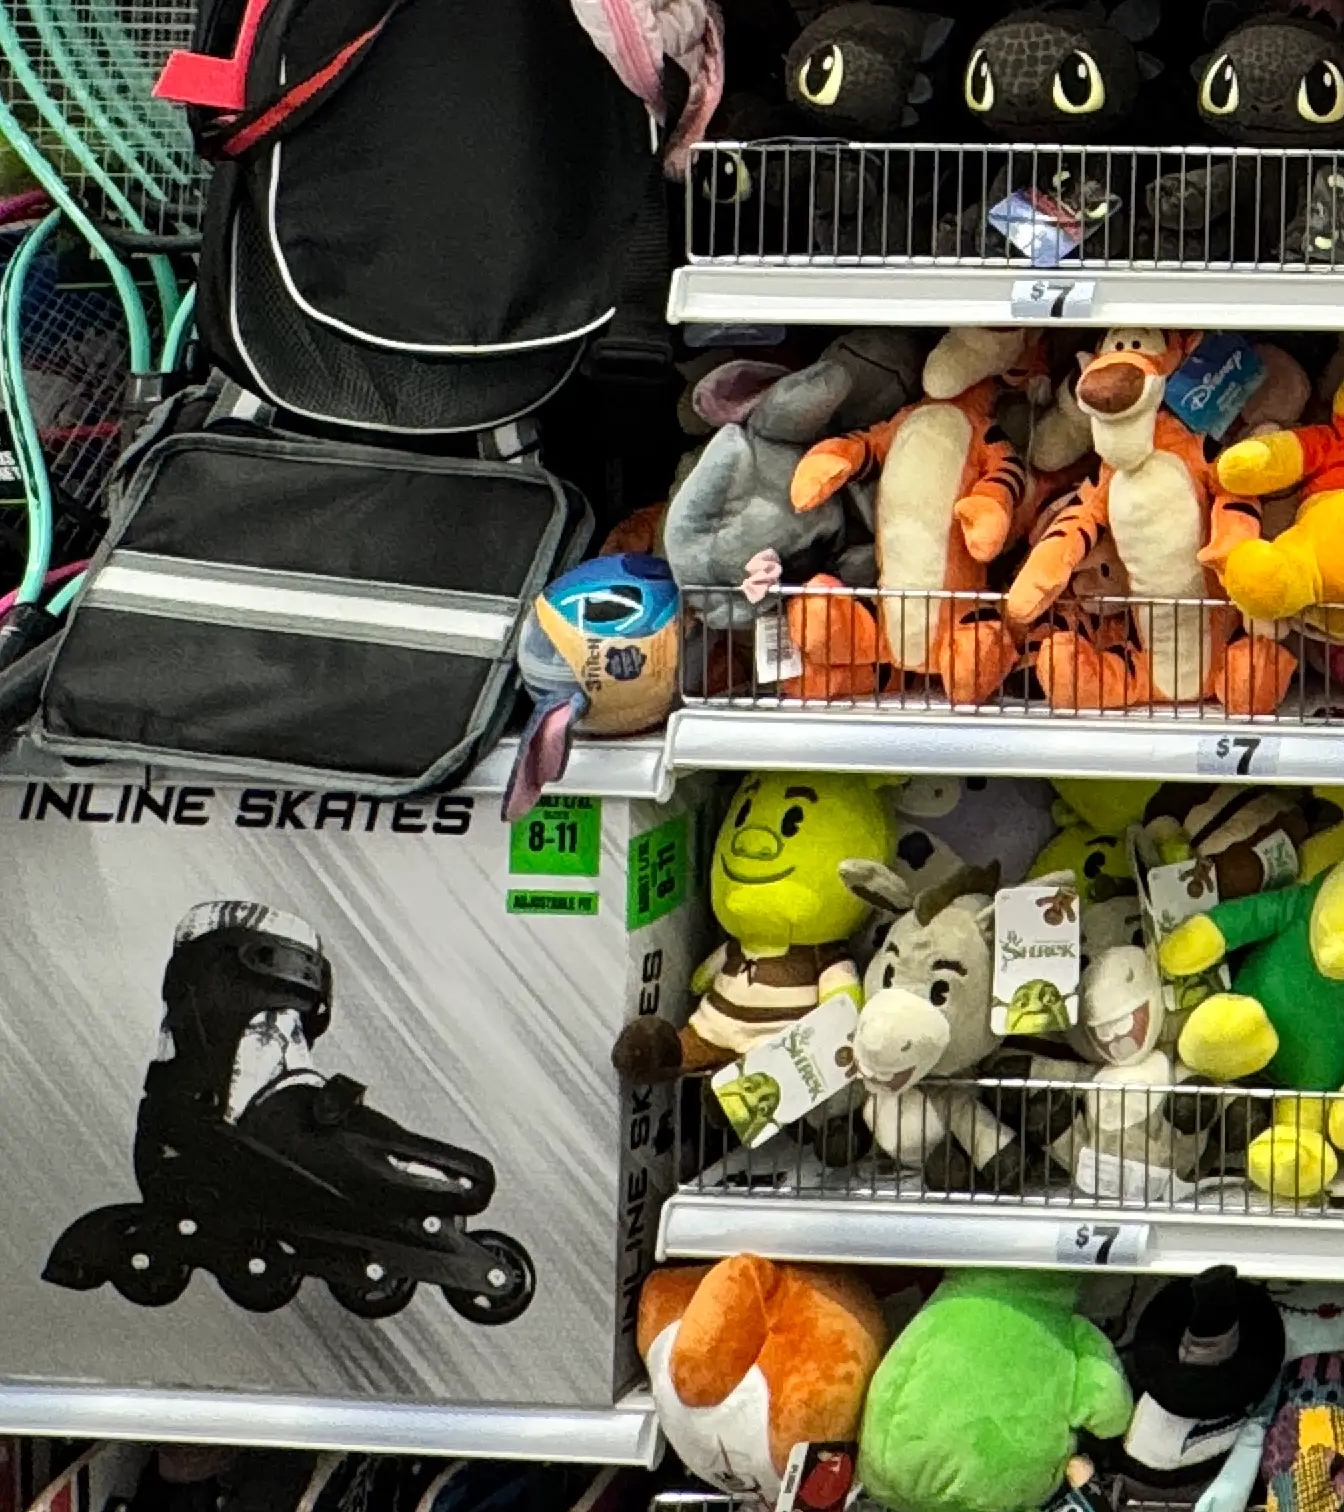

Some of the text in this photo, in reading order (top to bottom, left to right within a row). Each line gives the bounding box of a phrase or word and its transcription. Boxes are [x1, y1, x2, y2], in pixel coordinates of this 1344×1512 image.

[1030, 279, 1076, 318] $7
[1216, 735, 1261, 776] $7
[18, 781, 474, 836] INLINE SKATES
[528, 821, 578, 854] 8-11
[630, 948, 663, 1149] SKES
[1075, 1224, 1120, 1265] $7
